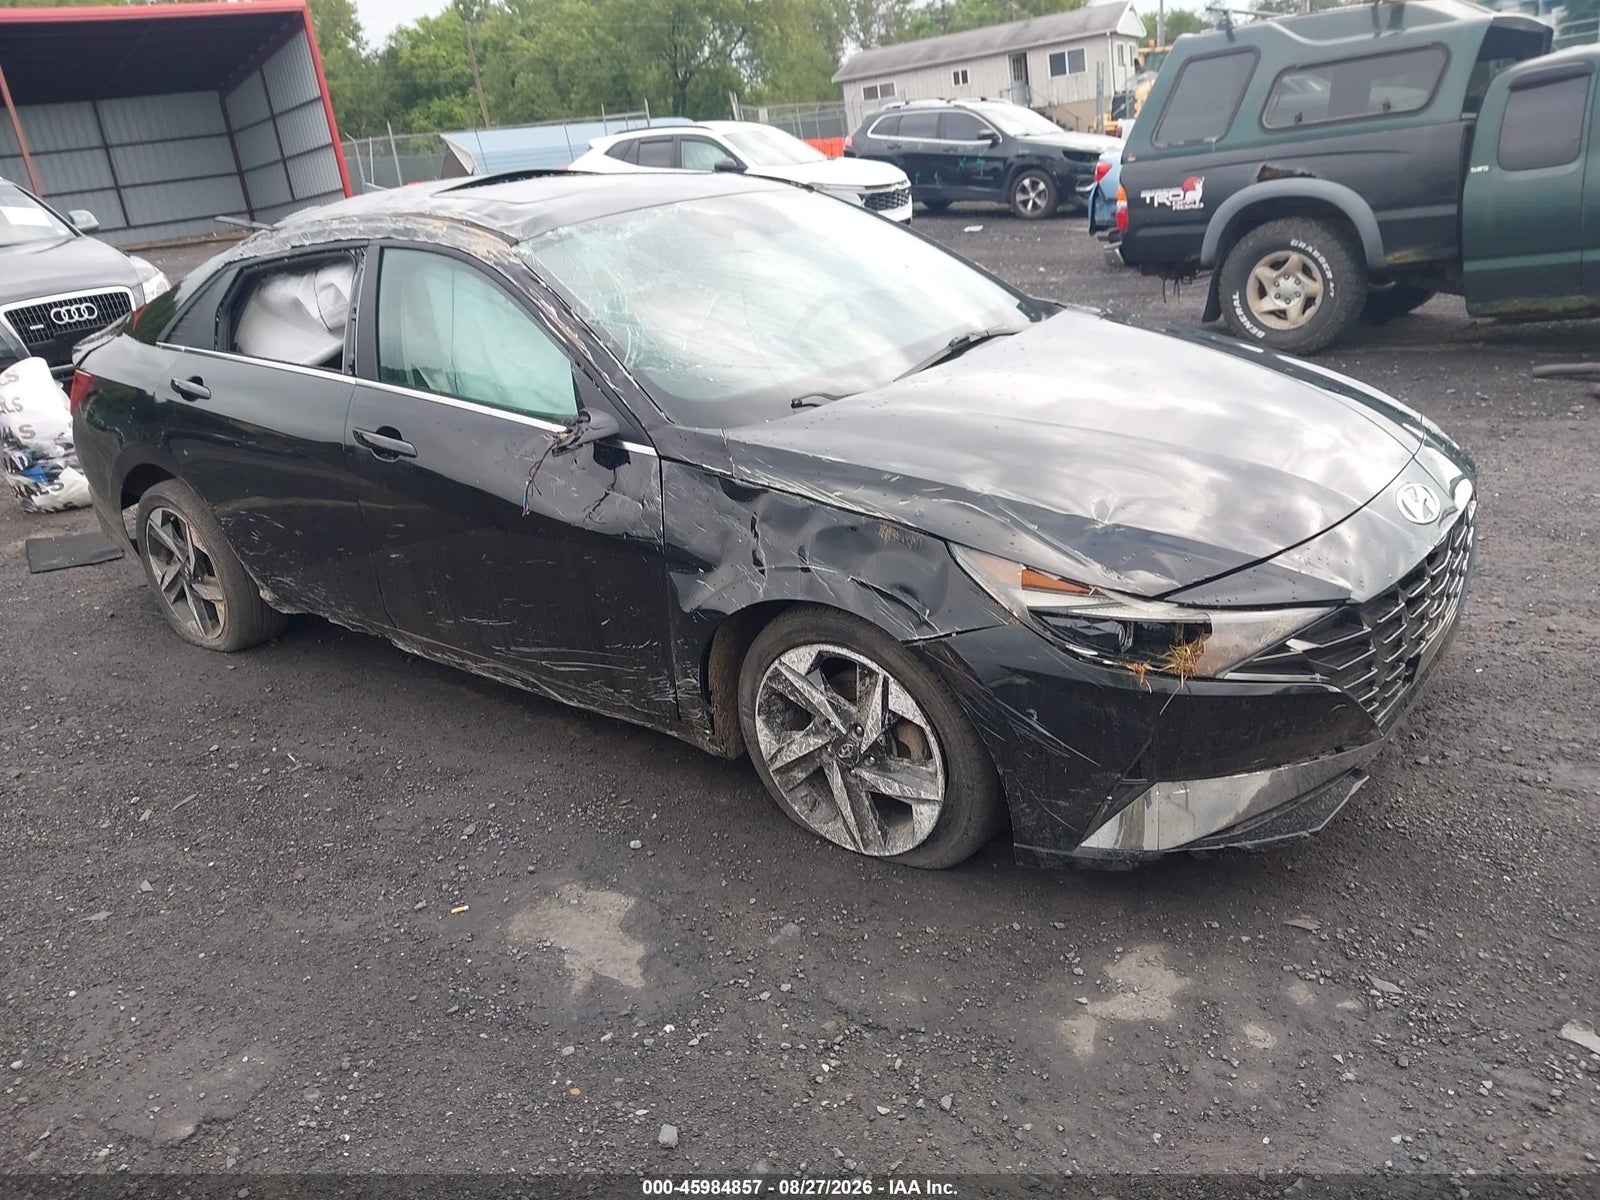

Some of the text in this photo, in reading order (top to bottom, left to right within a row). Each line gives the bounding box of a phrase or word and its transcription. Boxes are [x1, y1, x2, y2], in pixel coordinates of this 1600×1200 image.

[1140, 189, 1185, 208] TRD
[1290, 239, 1333, 279] GRABBER
[1232, 291, 1266, 339] GENERAL
